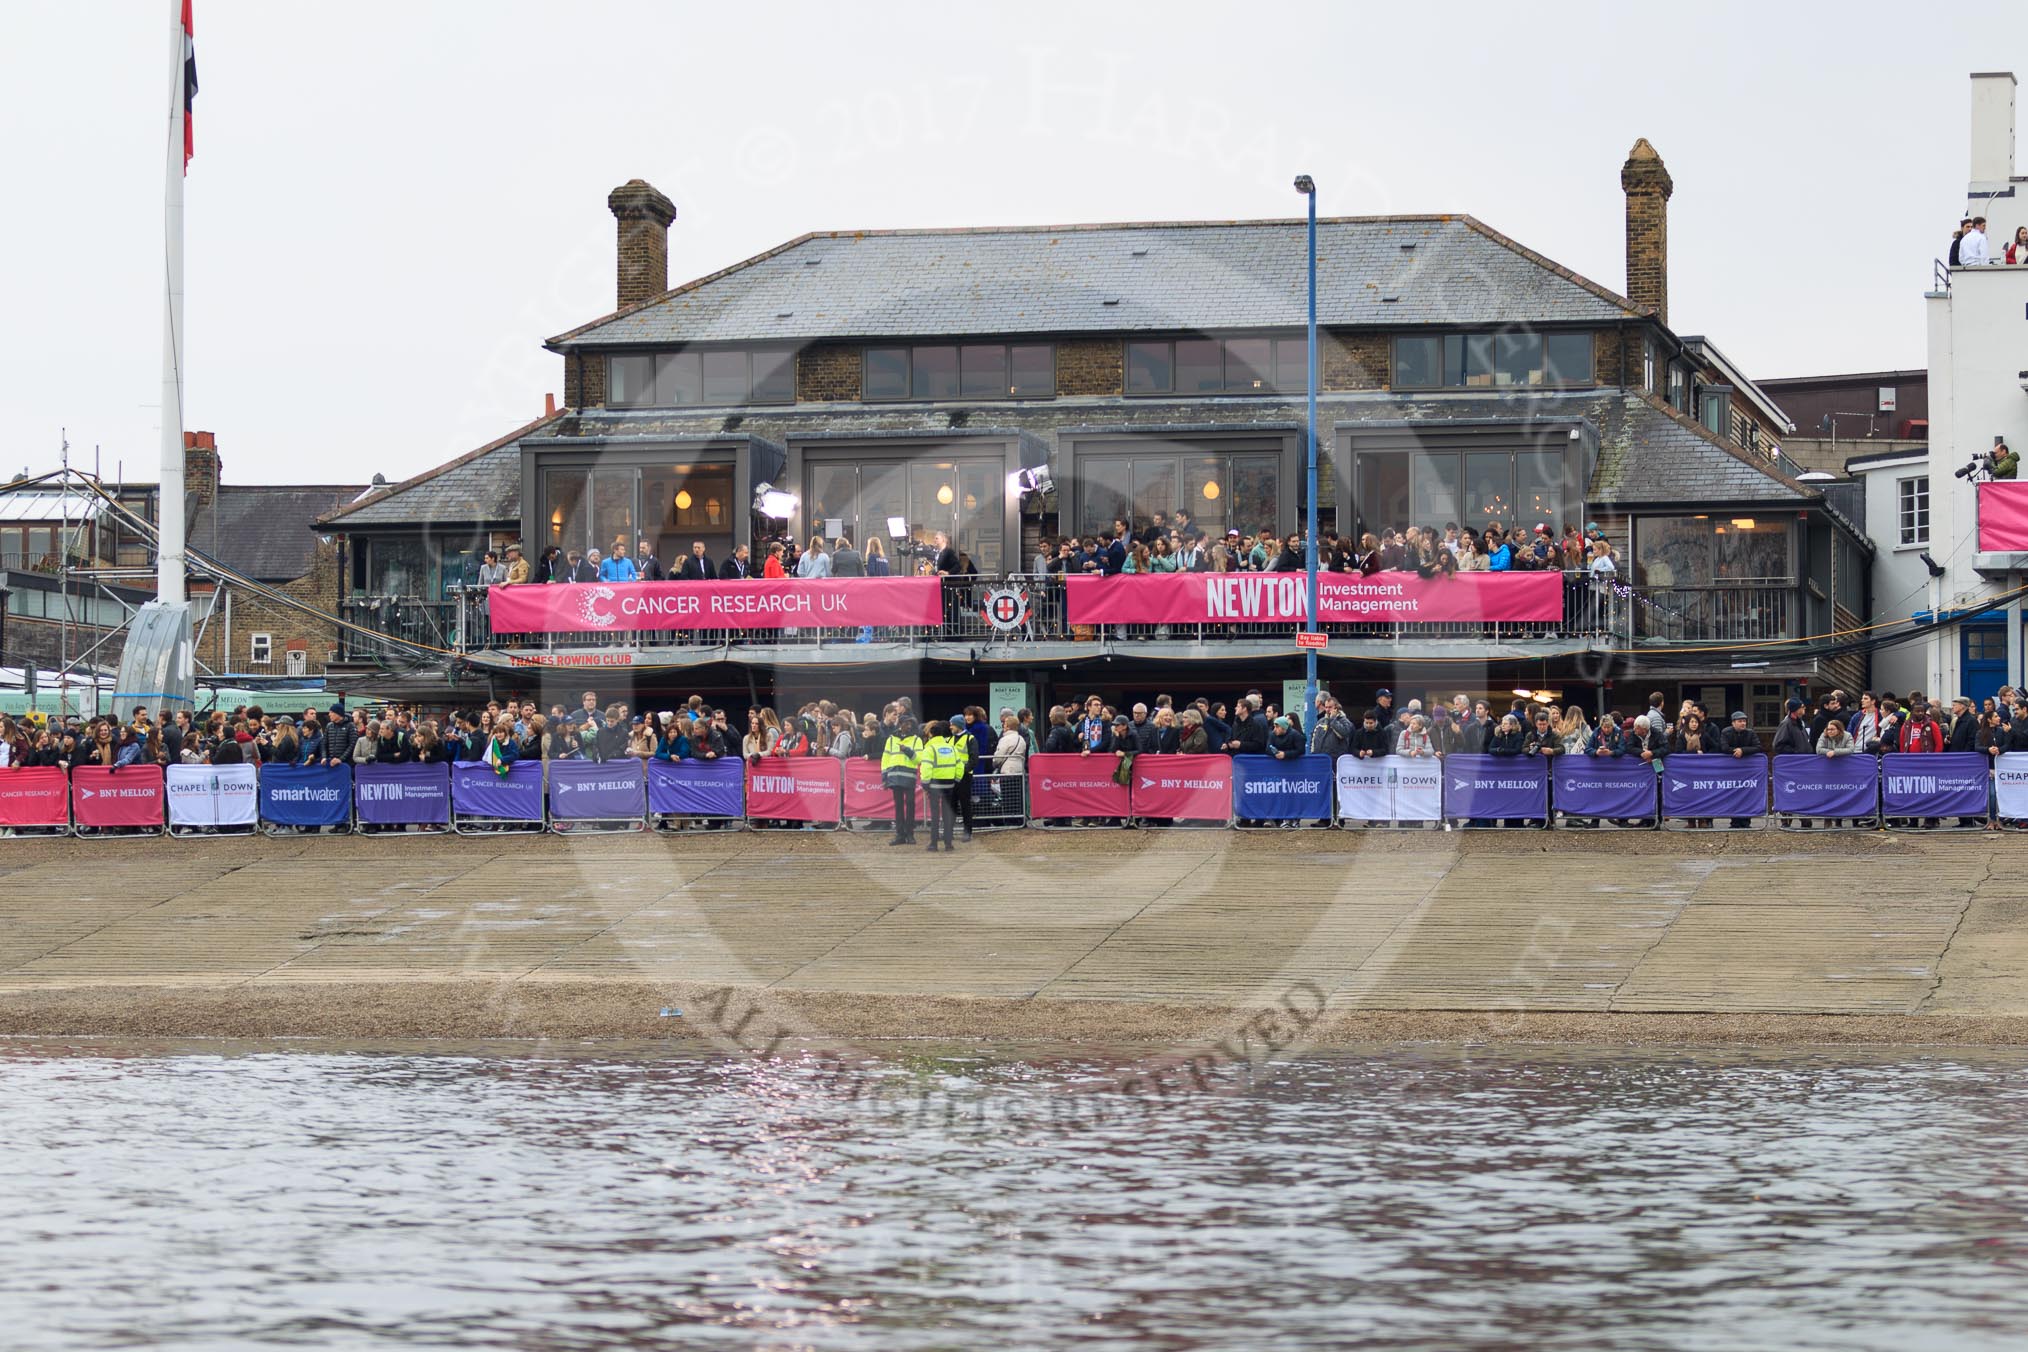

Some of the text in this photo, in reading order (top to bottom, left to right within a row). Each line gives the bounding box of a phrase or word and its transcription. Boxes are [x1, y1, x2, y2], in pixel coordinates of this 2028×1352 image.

[1319, 582, 1403, 596] Investment
[1206, 576, 1309, 618] NEWTON
[621, 593, 848, 615] CANCER RESEARCH UK
[1319, 596, 1418, 613] Management
[509, 654, 632, 666] THAMES ROWING CLUB
[577, 780, 636, 792] BNY MELLON
[752, 775, 795, 794] NEWTON
[796, 779, 830, 787] Investment
[1160, 779, 1223, 790] BNY MELLON
[1244, 777, 1320, 794] smartwater
[1340, 776, 1437, 785] CHAPEL DOWN
[1474, 780, 1538, 789] BNY MELLON
[1692, 779, 1758, 790] BNY MELLON
[1888, 775, 1936, 794] NEWTON
[1938, 777, 1977, 785] Investment
[99, 788, 156, 797] BNY MELLON
[170, 783, 254, 792] CHAPEL DOWN
[360, 783, 403, 800] NEWTON
[404, 784, 438, 792] Investment
[796, 786, 835, 795] Management
[1796, 783, 1823, 791] CANCER
[1825, 783, 1858, 791] RESEARCH
[1938, 784, 1982, 793] Management
[270, 786, 341, 801] smartwater
[404, 790, 444, 798] Management
